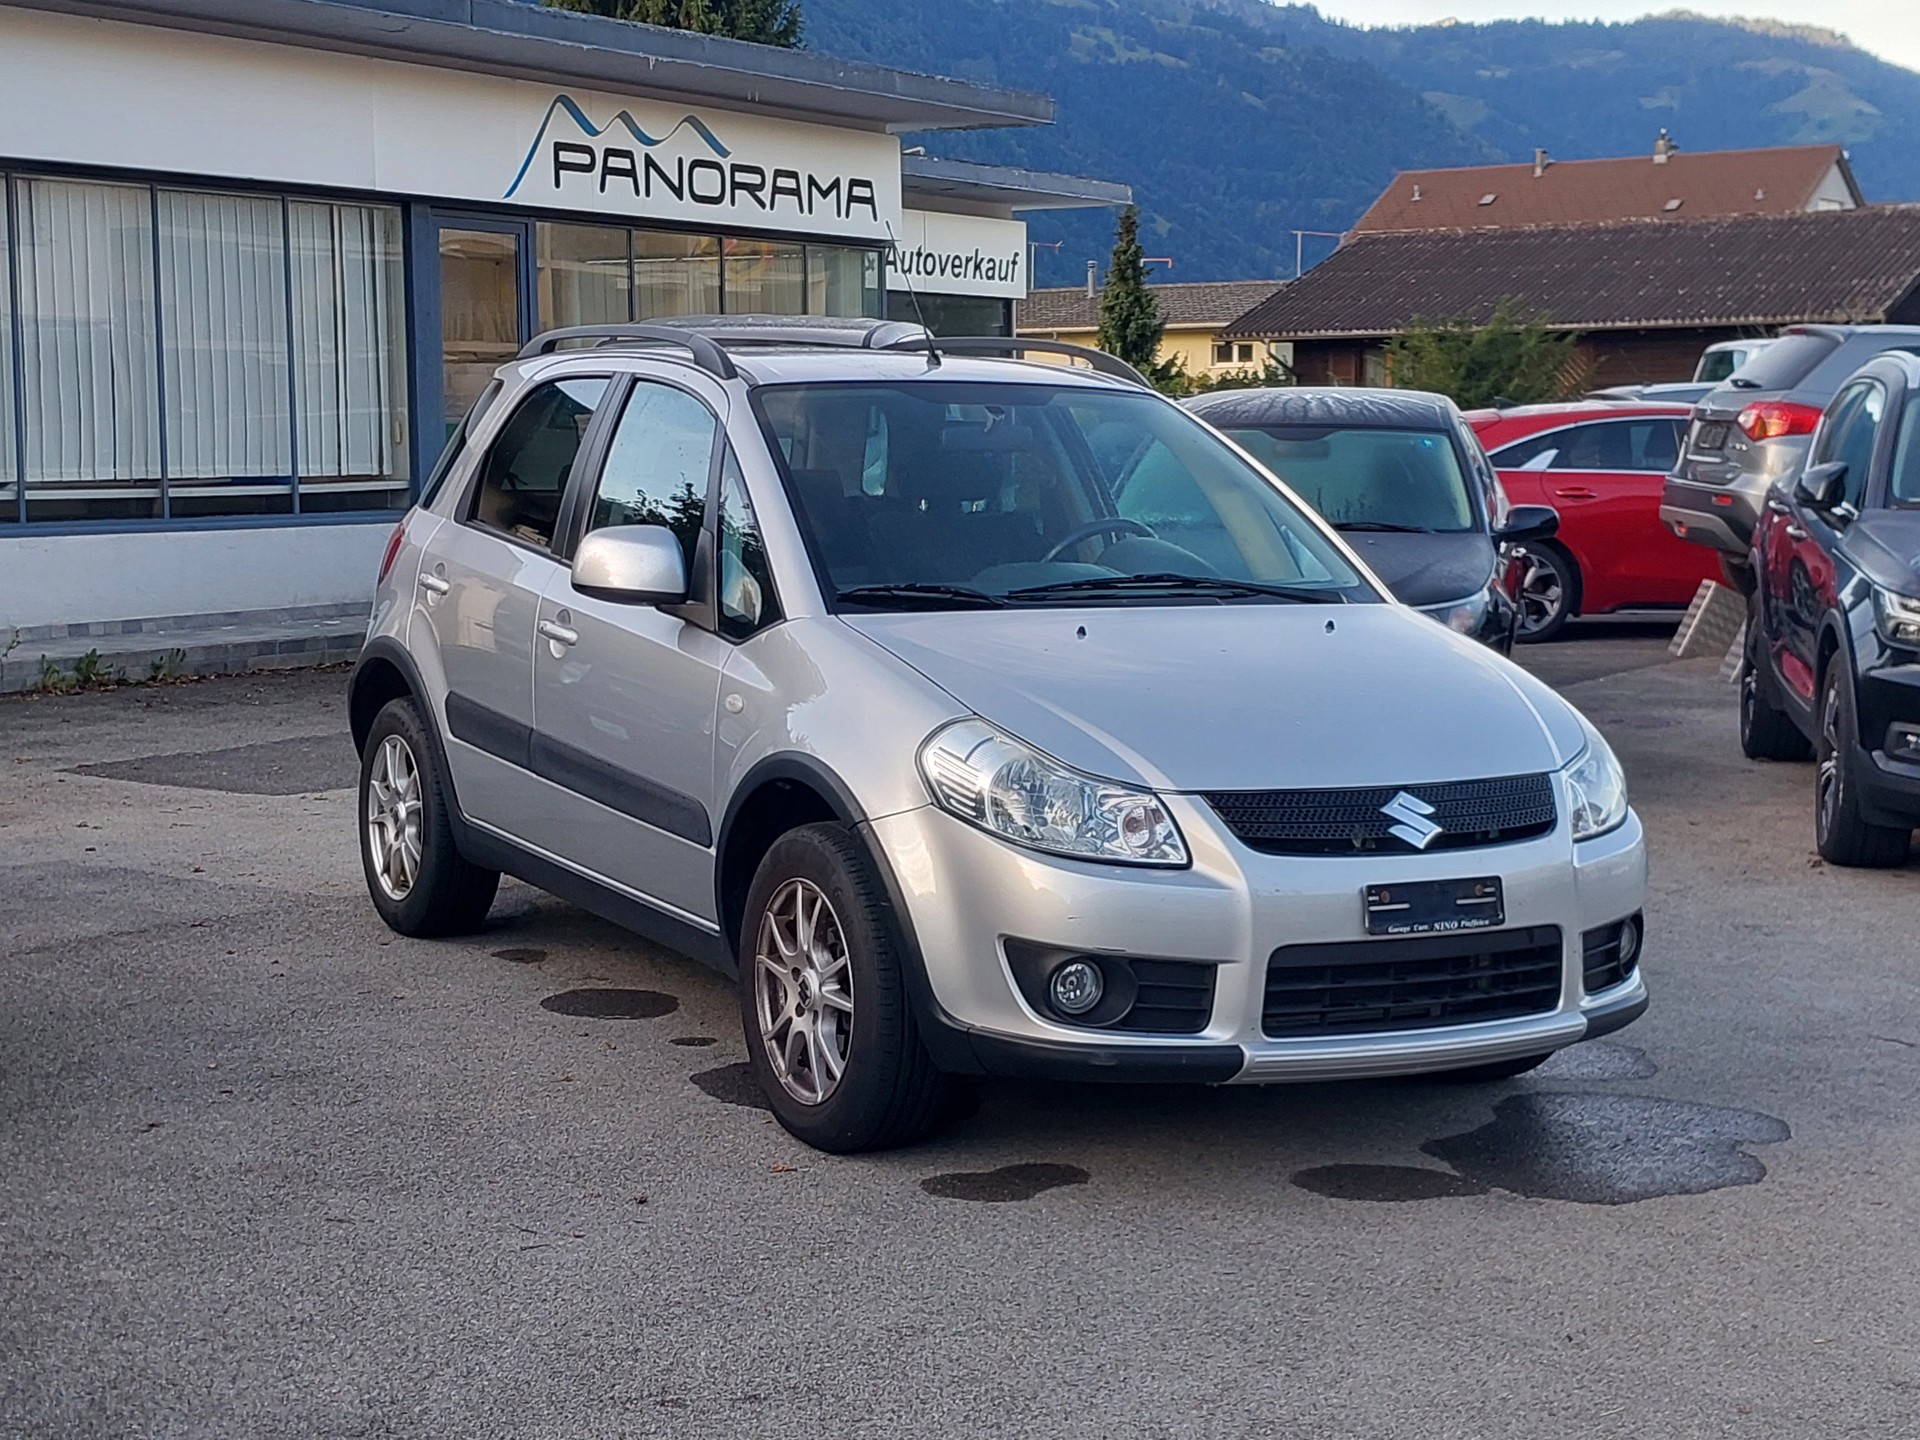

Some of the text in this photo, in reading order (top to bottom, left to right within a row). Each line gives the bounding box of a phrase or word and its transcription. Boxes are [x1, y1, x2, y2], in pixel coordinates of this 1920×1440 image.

[553, 141, 878, 222] PANORAMA
[885, 244, 1020, 283] Autoverkauf
[1433, 920, 1459, 931] NINO
